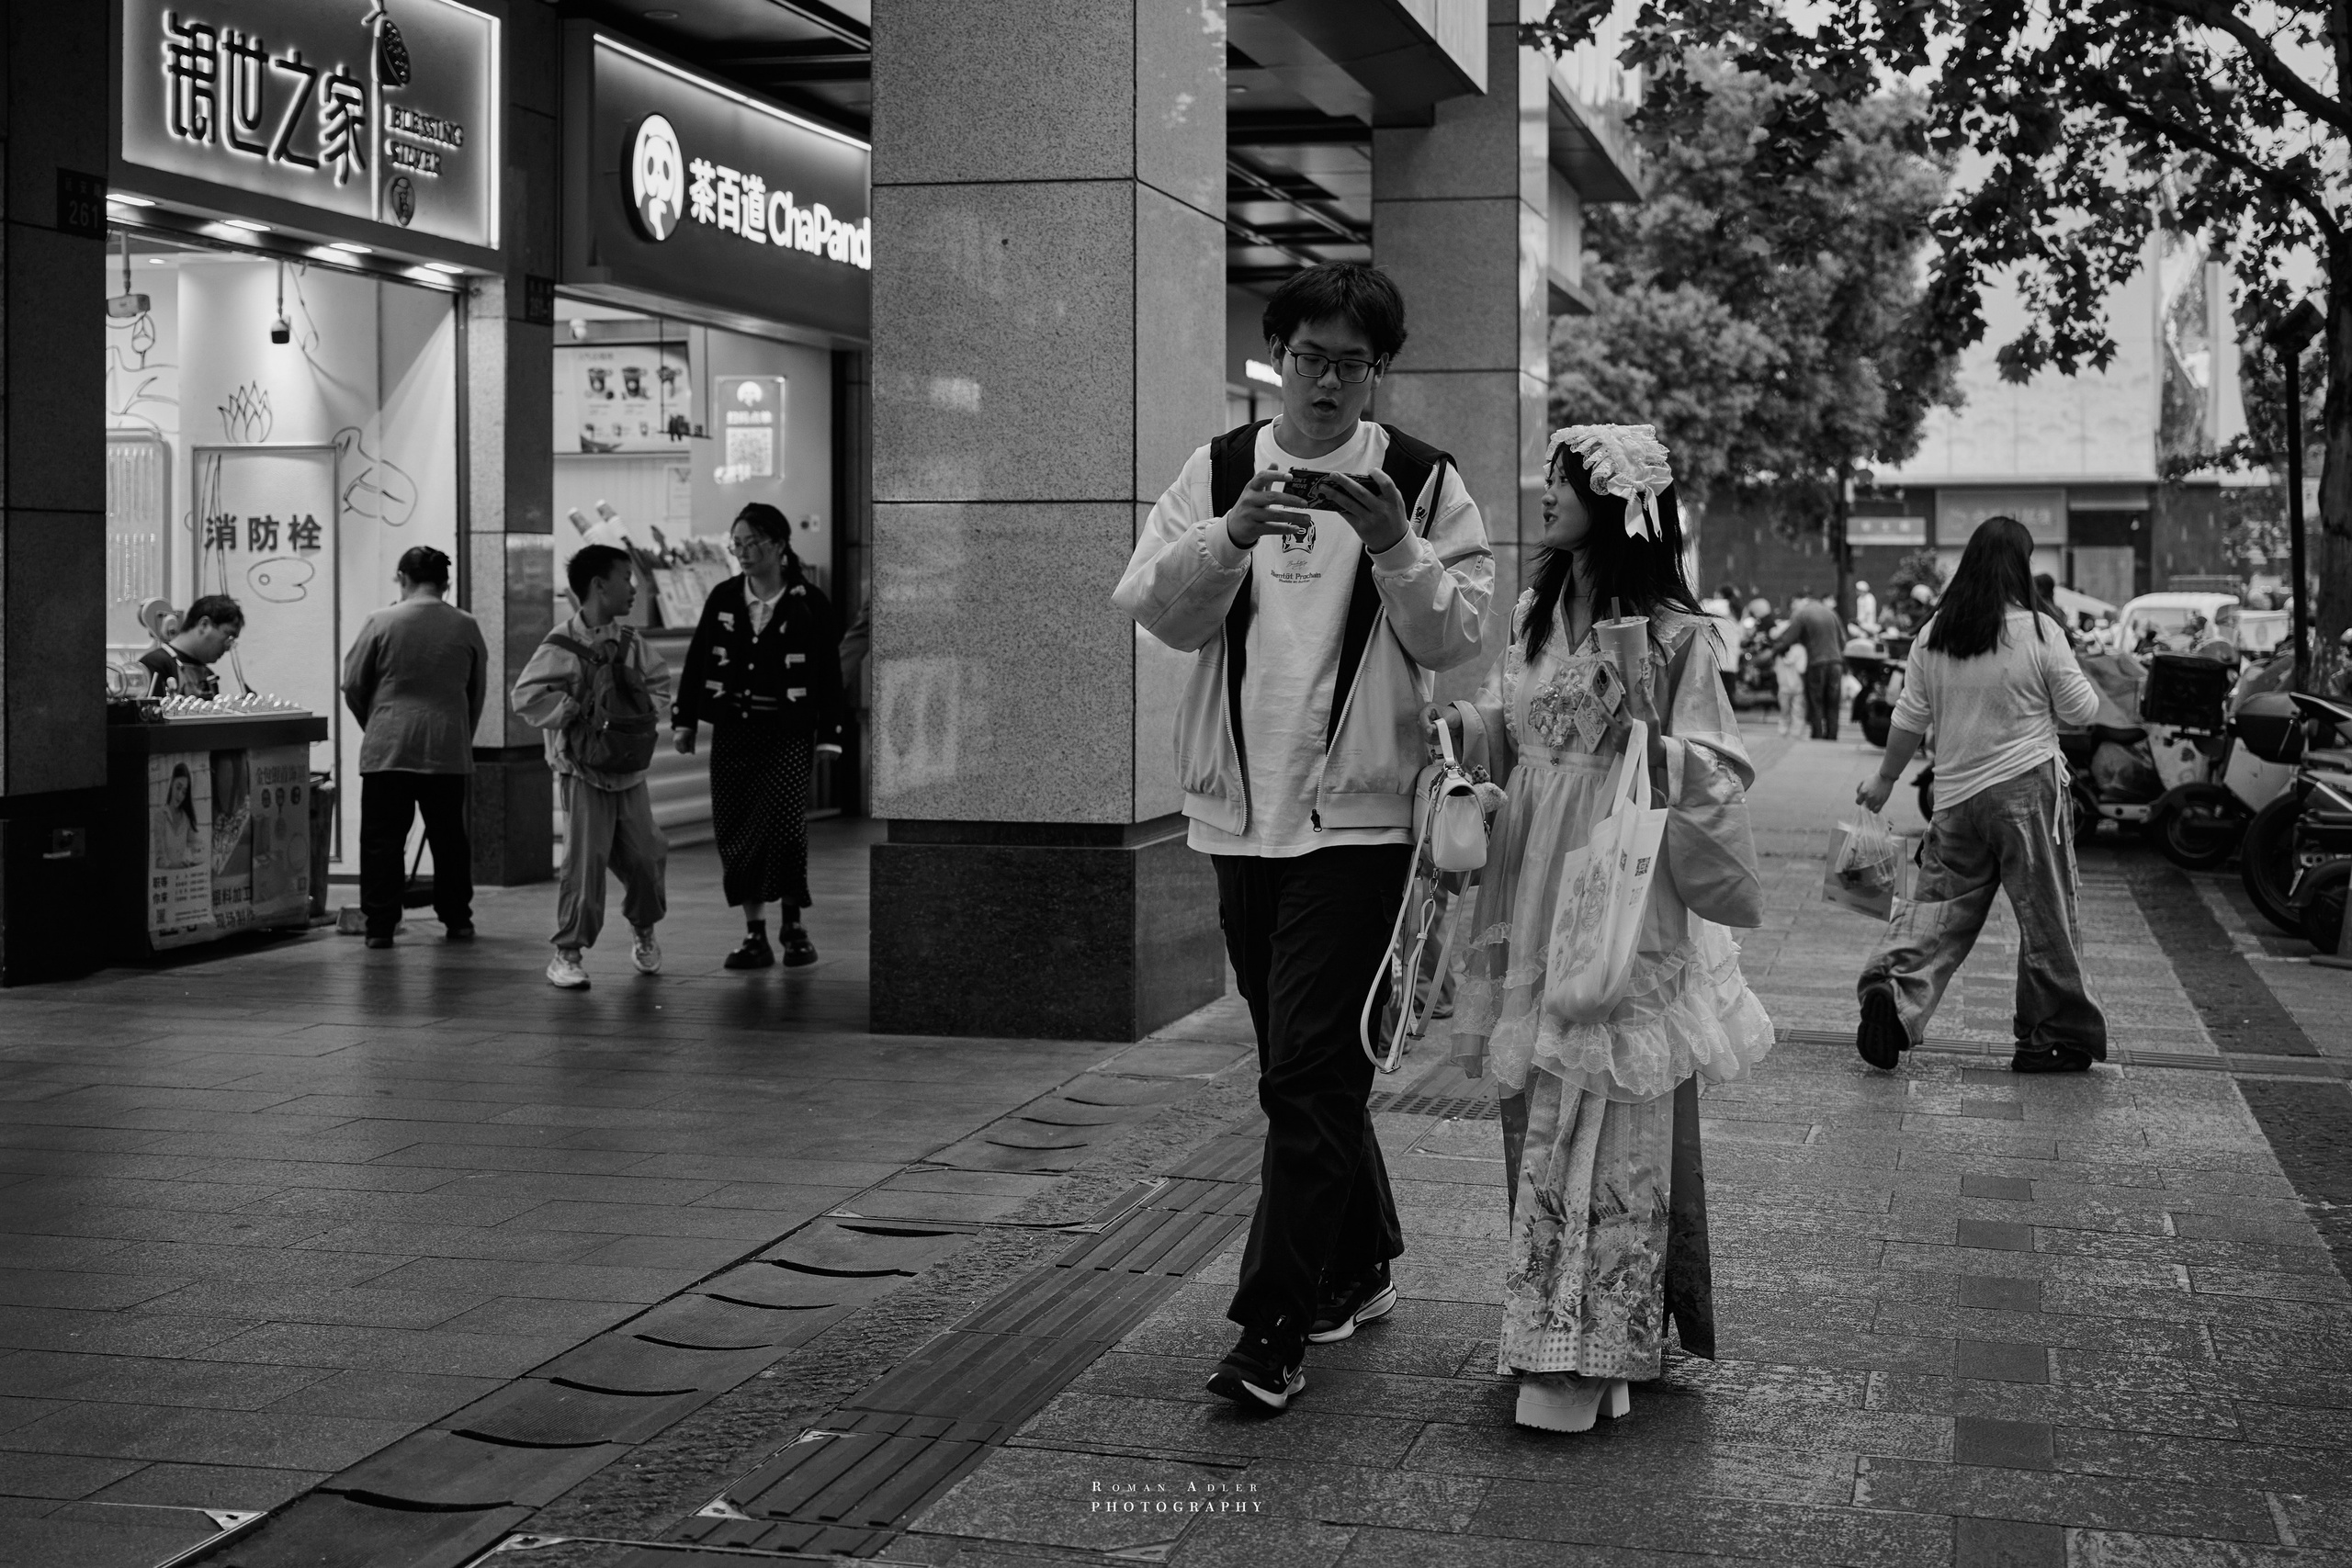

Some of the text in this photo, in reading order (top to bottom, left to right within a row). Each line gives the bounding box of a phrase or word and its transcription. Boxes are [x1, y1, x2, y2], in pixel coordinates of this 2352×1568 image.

[387, 104, 464, 149] BLESSING
[387, 140, 442, 176] SILVER
[69, 199, 98, 229] 261
[689, 157, 766, 244] 茶百道
[205, 513, 322, 551] 消防栓
